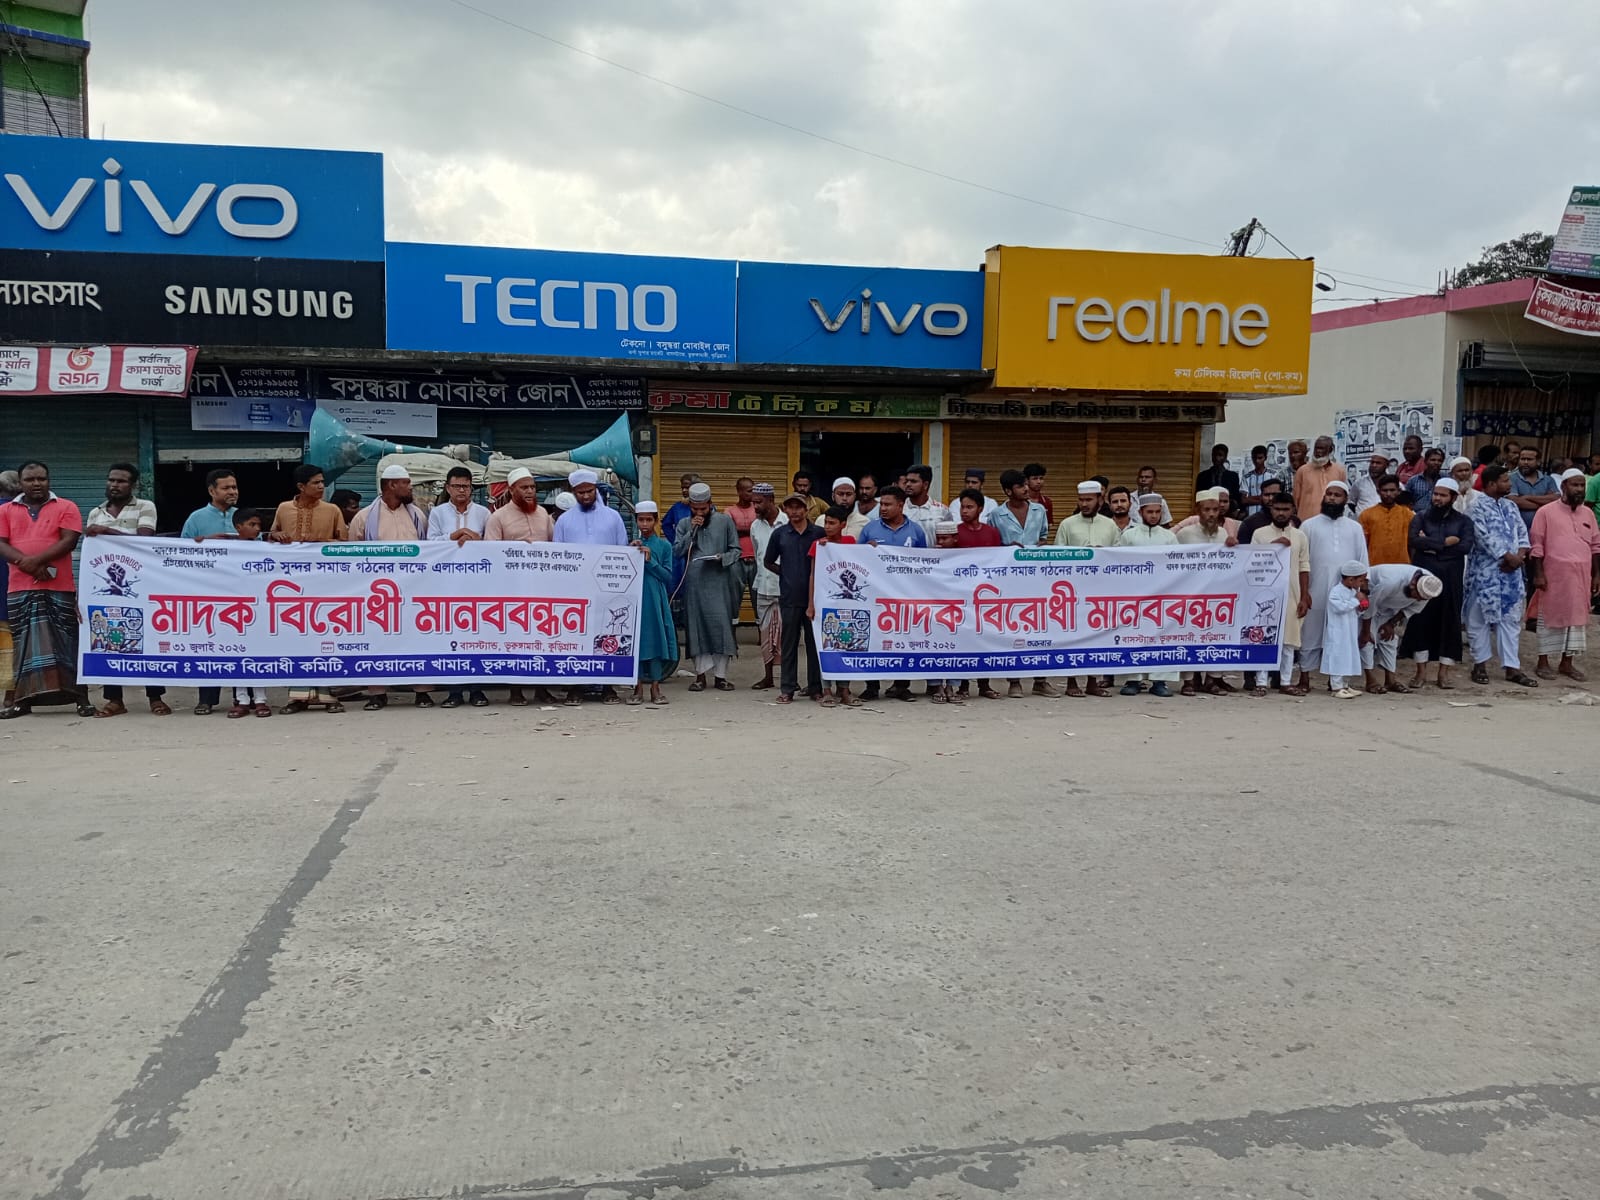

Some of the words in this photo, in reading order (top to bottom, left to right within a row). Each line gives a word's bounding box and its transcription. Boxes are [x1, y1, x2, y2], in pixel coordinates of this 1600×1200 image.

[4, 157, 298, 239] vivo
[165, 285, 354, 319] SAMSUNG
[444, 273, 678, 333] TECNO
[808, 287, 968, 336] vivo
[1048, 287, 1270, 347] realme
[5, 358, 30, 369] মানি
[126, 365, 151, 375] ক্যাশ
[152, 364, 182, 375] আউট
[58, 372, 100, 386] নগদ
[141, 376, 164, 387] চার্জ
[328, 377, 410, 403] বসুন্ধরা
[418, 377, 509, 405] মোবাইল
[517, 382, 572, 404] জোন
[89, 556, 103, 568] SAY
[105, 553, 115, 562] NO
[120, 555, 143, 571] DRUGS
[241, 558, 276, 573] একটি
[280, 561, 312, 576] সুন্দর
[316, 561, 351, 574] সমাজ
[356, 558, 395, 574] গঠনের
[431, 558, 493, 574] এলাকাবাসী
[825, 563, 837, 574] SAY
[839, 561, 848, 569] NO
[953, 564, 979, 577] একটি
[981, 566, 1007, 580] সুন্দর
[1010, 565, 1037, 577] সমাজ
[1040, 562, 1072, 576] গঠনের
[1103, 562, 1155, 576] এলাকাবাসী
[148, 594, 257, 636] মাদক
[266, 578, 404, 635] বিরোধী
[412, 596, 590, 637] মানববন্ধন
[875, 598, 965, 635] মাদক
[973, 580, 1077, 633] বিরোধী
[1085, 593, 1238, 630] মানববন্ধন
[173, 642, 186, 652] ৩১
[190, 641, 216, 654] জুলাই
[219, 643, 246, 653] ২০২৬
[337, 643, 369, 652] শুক্রবার
[894, 642, 906, 650] ৩১
[909, 640, 929, 651] জুলাই
[932, 642, 956, 651] ২০২৬
[106, 657, 177, 674] আয়োজনে
[195, 661, 237, 674] মাদক
[240, 656, 294, 675] বিরোধী
[299, 656, 349, 676] কমিটি,
[354, 658, 425, 673] দেওয়ানের
[431, 659, 476, 674] খামার,
[480, 655, 551, 675] ভূরুঙ্গামারী,
[841, 655, 903, 669] আয়োজনে
[919, 656, 979, 669] দেওয়ানের
[984, 655, 1016, 668] খামার
[1021, 653, 1050, 666] তরুণ
[1055, 654, 1065, 664] ও
[1068, 652, 1084, 667] যুব
[1089, 651, 1126, 665] সমাজ,
[1130, 646, 1192, 666] ভূরুঙ্গামারী,
